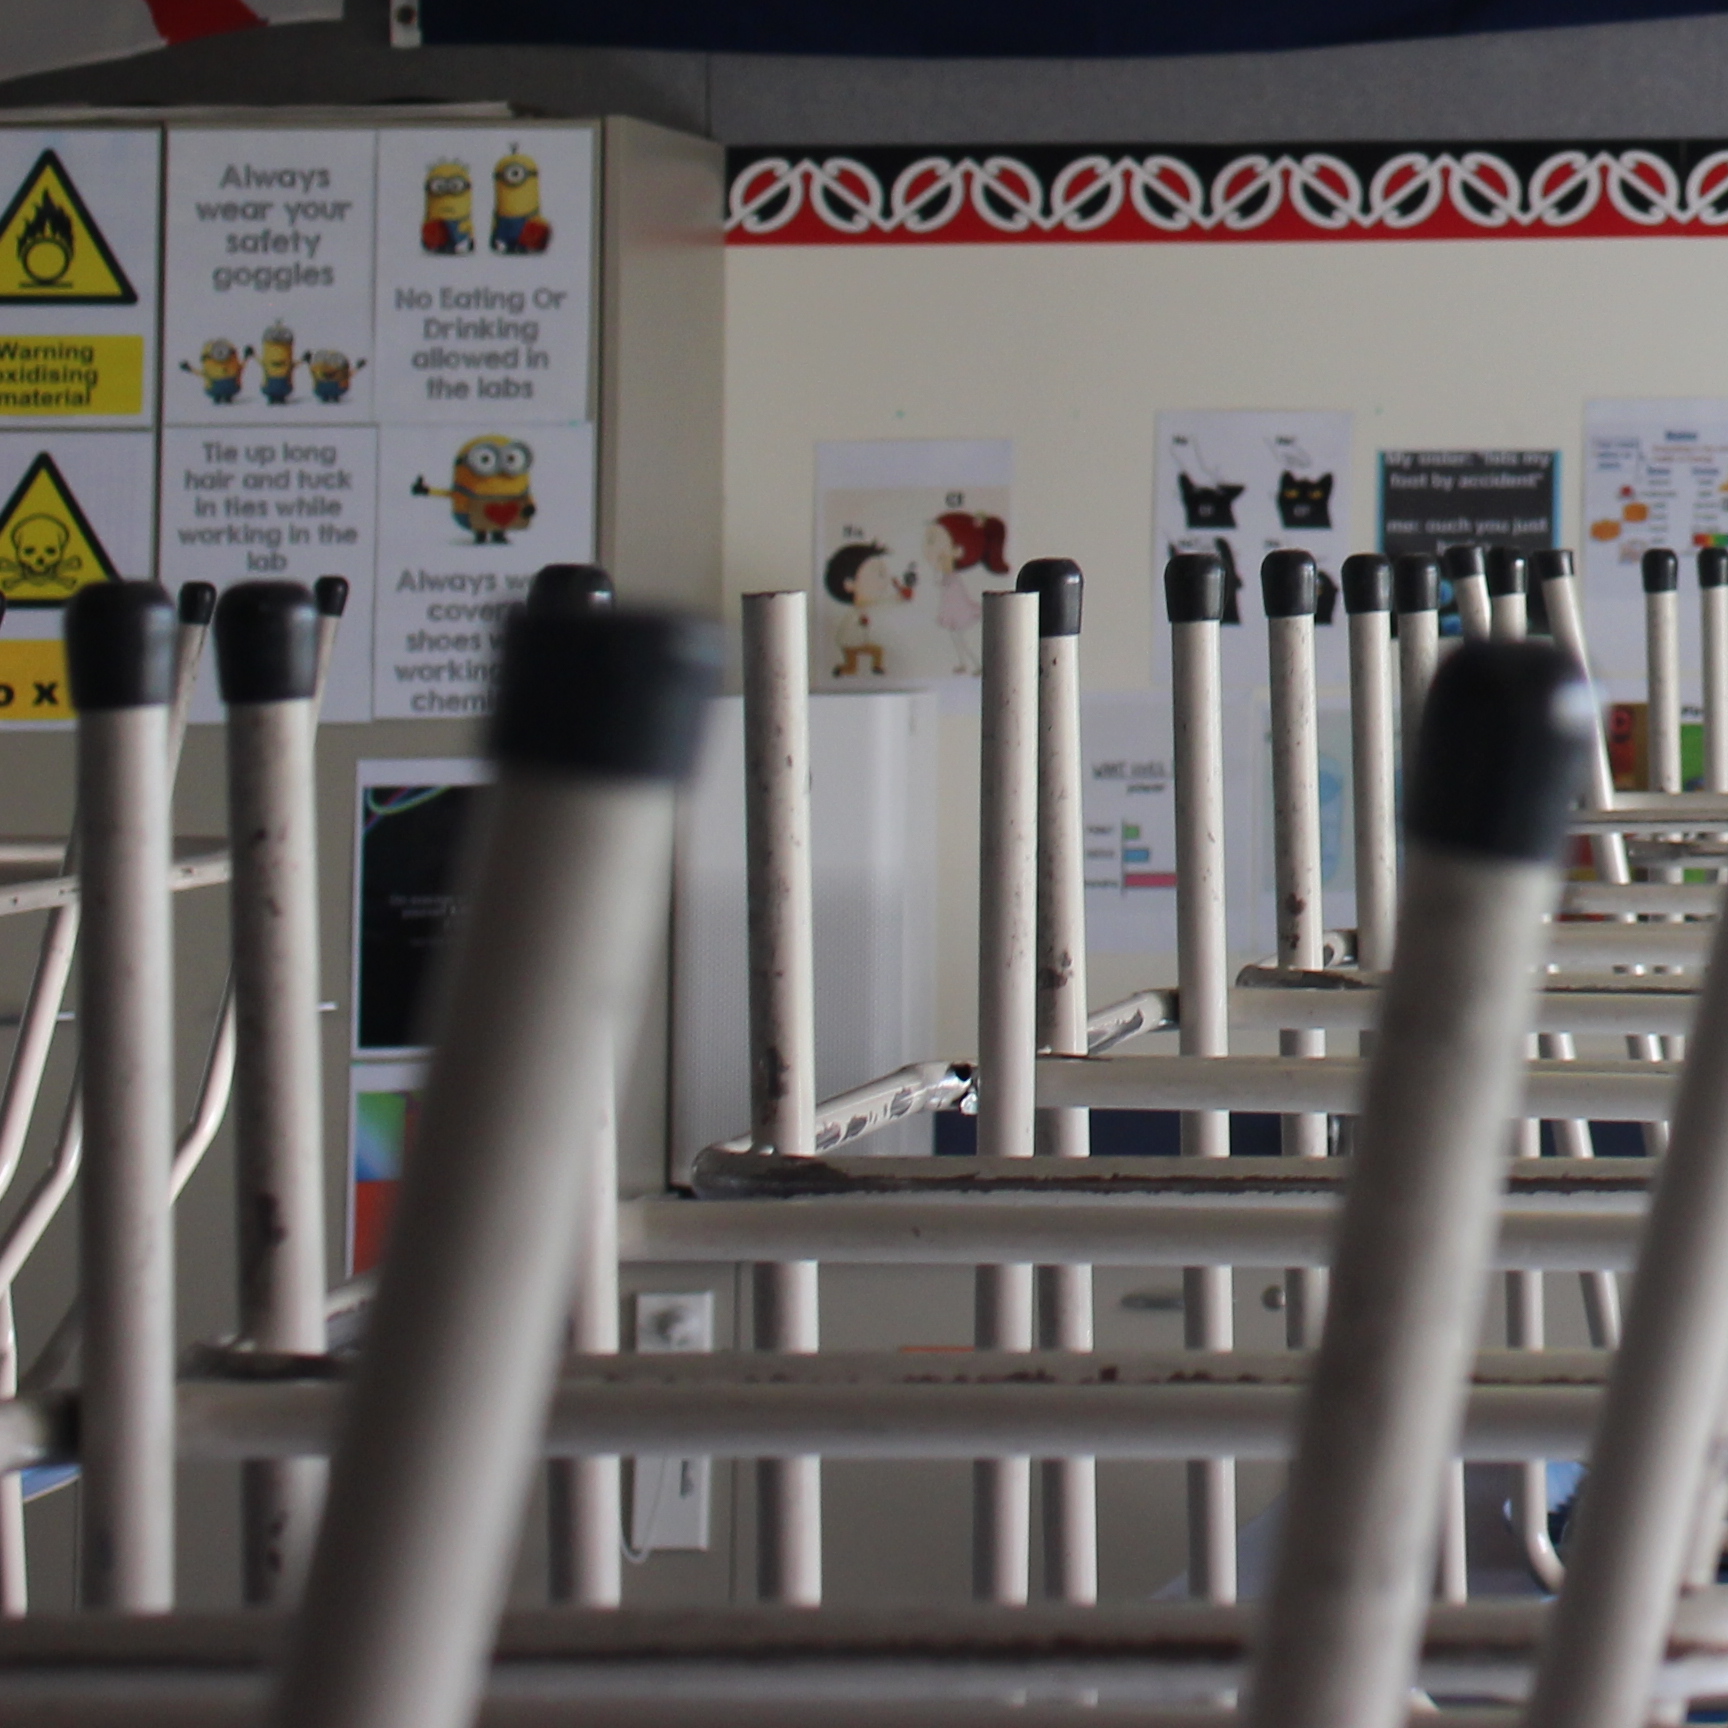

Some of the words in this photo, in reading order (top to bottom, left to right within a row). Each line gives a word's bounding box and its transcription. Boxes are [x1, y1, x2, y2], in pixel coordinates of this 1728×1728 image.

[219, 163, 330, 193] Always
[195, 201, 274, 220] wear
[283, 201, 353, 226] your
[226, 228, 321, 259] safety
[212, 261, 335, 292] goggles
[395, 287, 432, 310] No
[439, 286, 525, 314] Eating
[532, 286, 567, 310] Or
[423, 317, 539, 344] Drinking
[411, 346, 519, 369] allowed
[526, 346, 549, 369] in
[0, 365, 98, 389] xidising
[427, 376, 469, 399] the
[477, 376, 533, 399] labs
[203, 441, 238, 463] Tie
[245, 445, 276, 466] up
[283, 442, 337, 466] long
[184, 470, 234, 490] hair
[242, 470, 290, 490] and
[298, 469, 351, 489] tuck
[195, 496, 216, 517] in
[225, 496, 268, 517] ties
[275, 496, 342, 517] while
[178, 524, 282, 548] working
[289, 524, 310, 544] in
[318, 524, 358, 544] the
[247, 551, 288, 571] lab
[396, 569, 497, 595] Always
[406, 629, 480, 652] shoes
